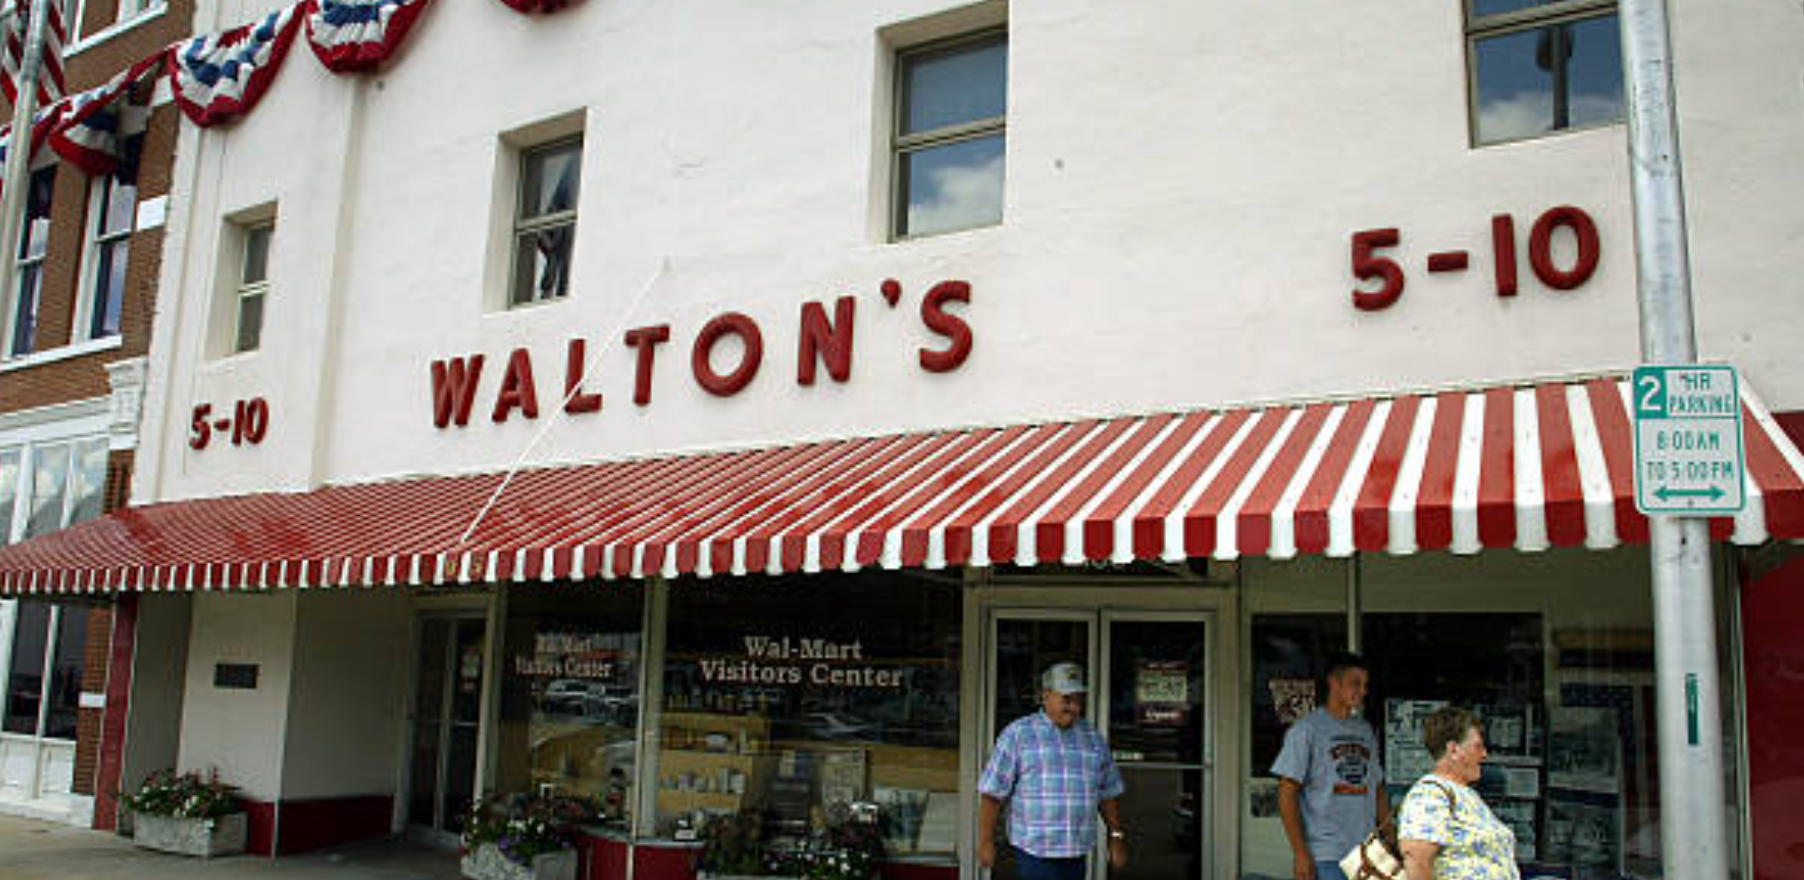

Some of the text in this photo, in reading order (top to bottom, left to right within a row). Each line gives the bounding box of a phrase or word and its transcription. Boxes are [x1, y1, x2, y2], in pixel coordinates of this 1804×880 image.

[1351, 204, 1601, 312] 5-10
[430, 278, 974, 429] WALTON'S
[1638, 375, 1662, 411] 2
[1669, 394, 1732, 413] PARKING
[188, 396, 270, 451] 5-10
[1646, 461, 1665, 481] TO
[744, 635, 863, 660] Wal-Mart
[701, 660, 904, 687] Visitors Center
